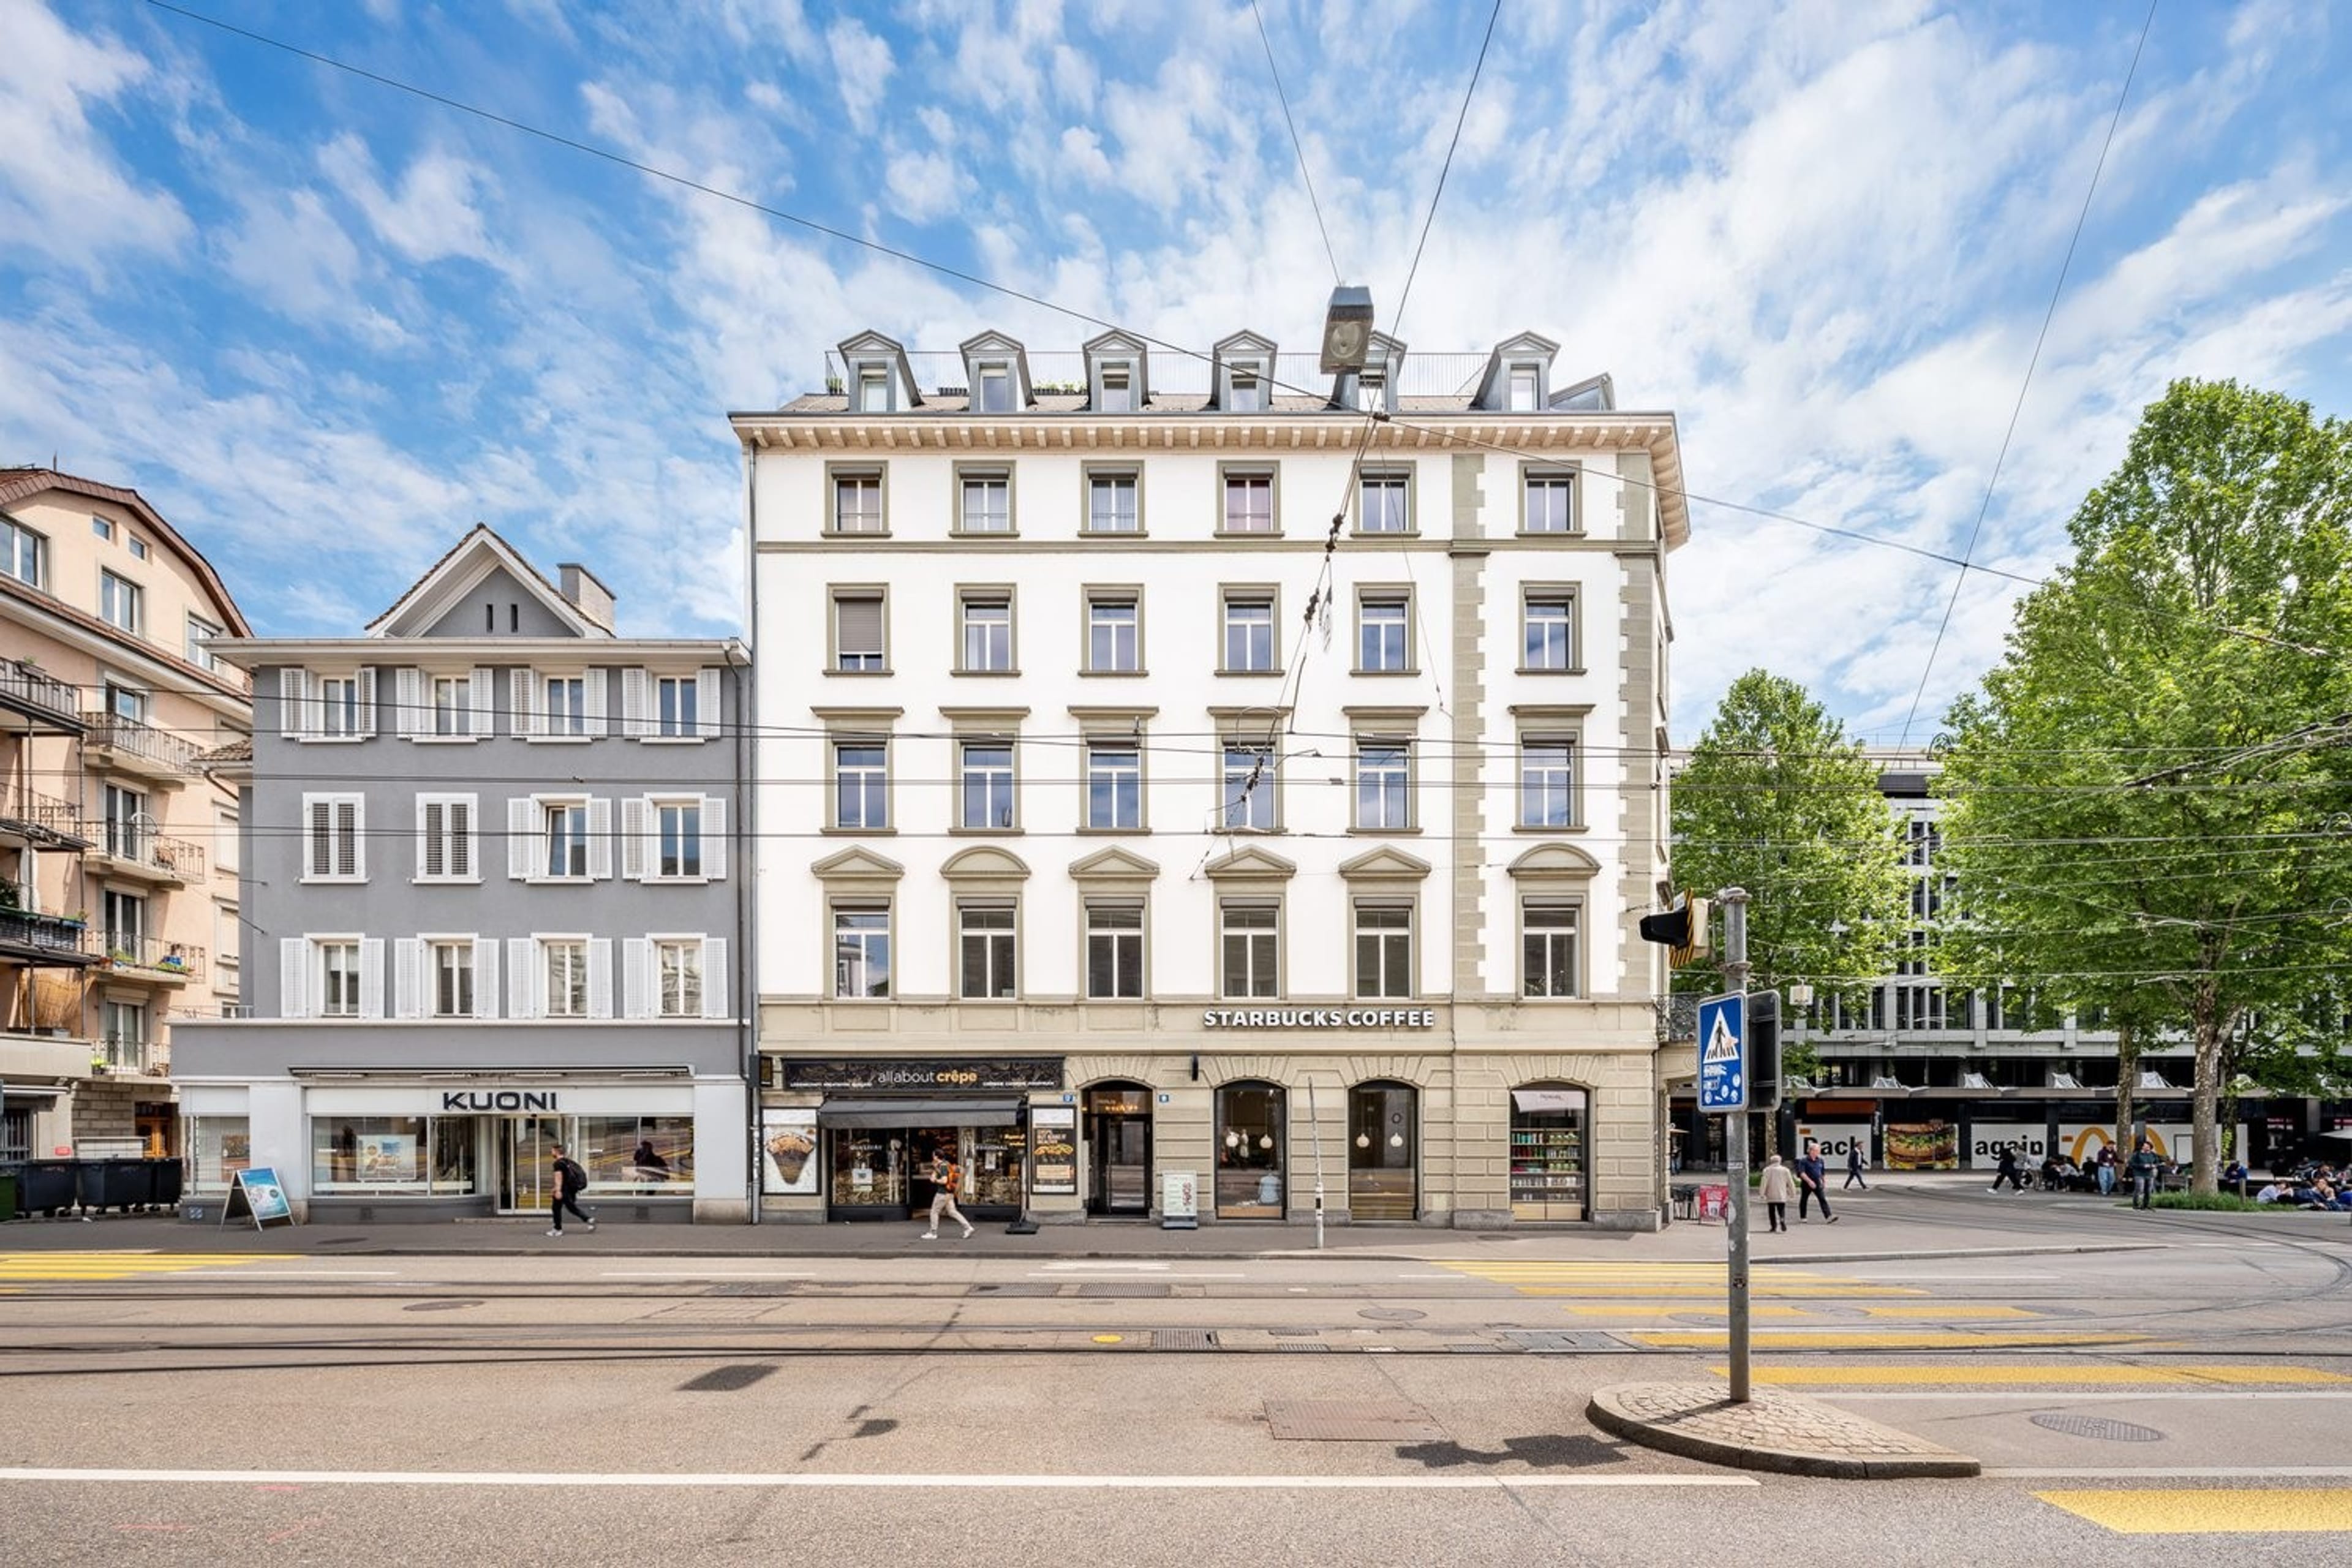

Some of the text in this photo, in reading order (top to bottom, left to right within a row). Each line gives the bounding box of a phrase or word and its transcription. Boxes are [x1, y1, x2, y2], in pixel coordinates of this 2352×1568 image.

[1204, 1010, 1435, 1027] STARBUCKS COFFEE
[937, 1069, 978, 1084] crêpe
[443, 1091, 557, 1110] KUONI
[1975, 1134, 2043, 1161] again
